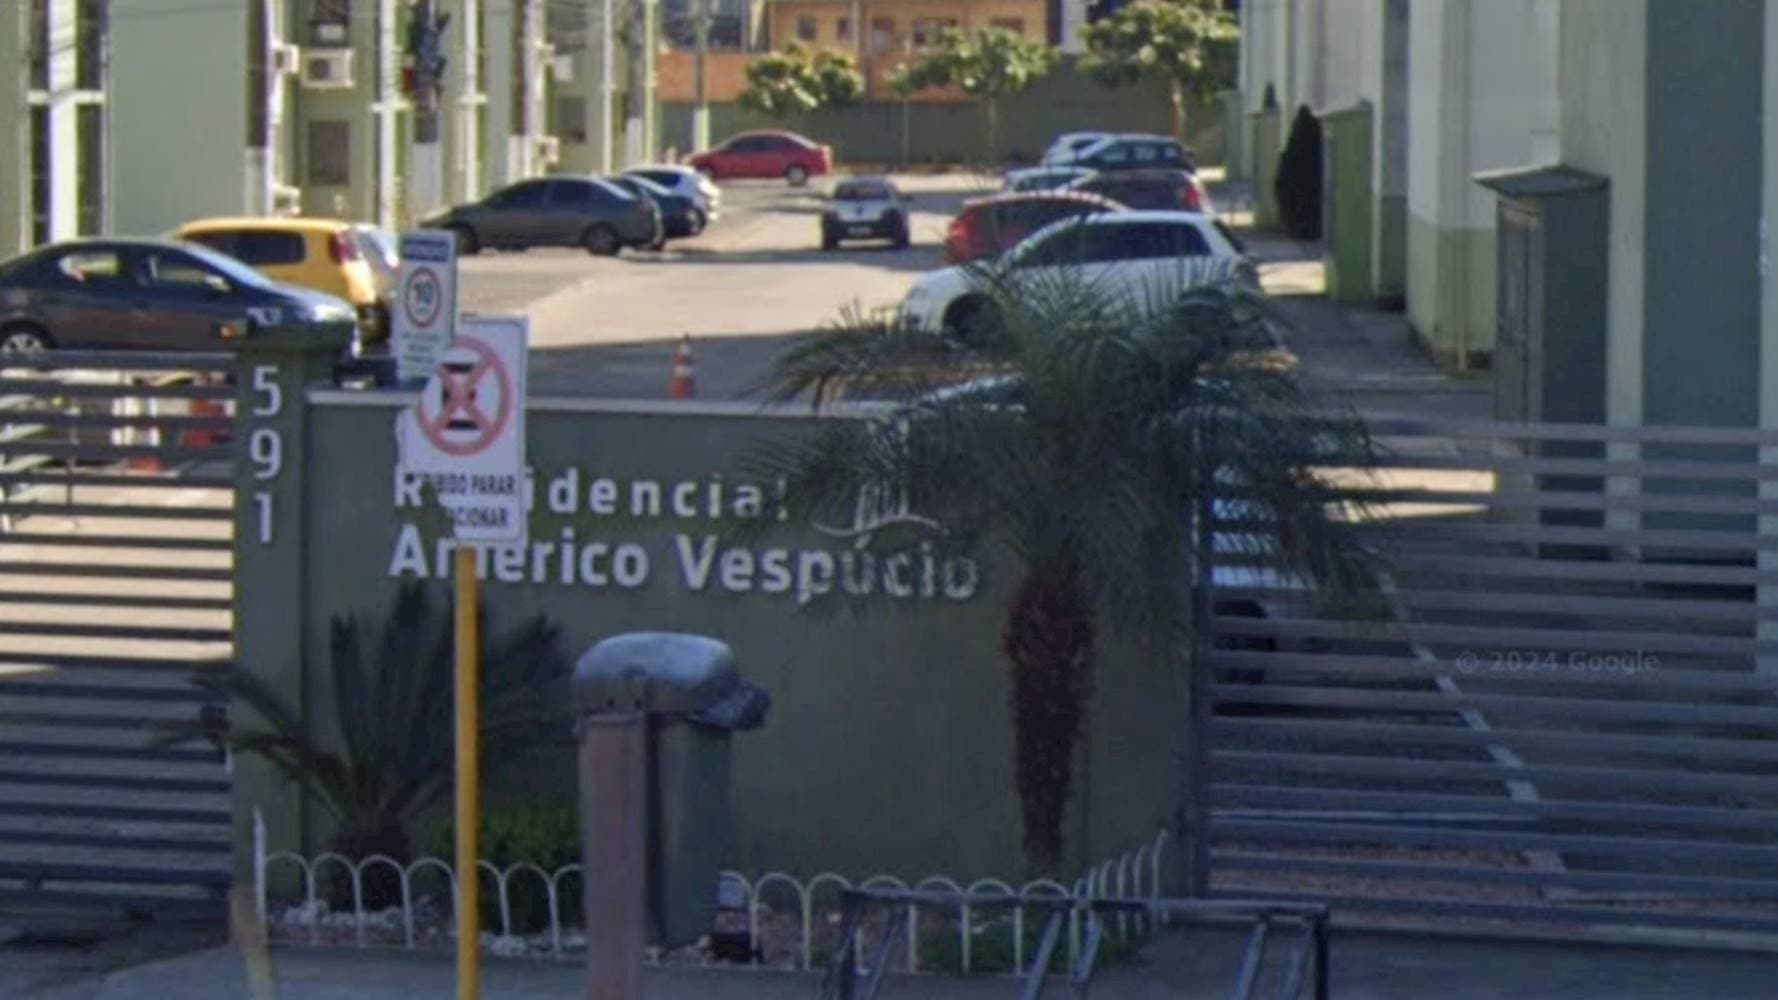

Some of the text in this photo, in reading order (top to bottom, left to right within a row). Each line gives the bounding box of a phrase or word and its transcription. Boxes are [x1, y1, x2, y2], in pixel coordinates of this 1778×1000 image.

[250, 366, 282, 543] 591
[471, 474, 515, 495] PARAR
[675, 533, 978, 604] Vespúcio
